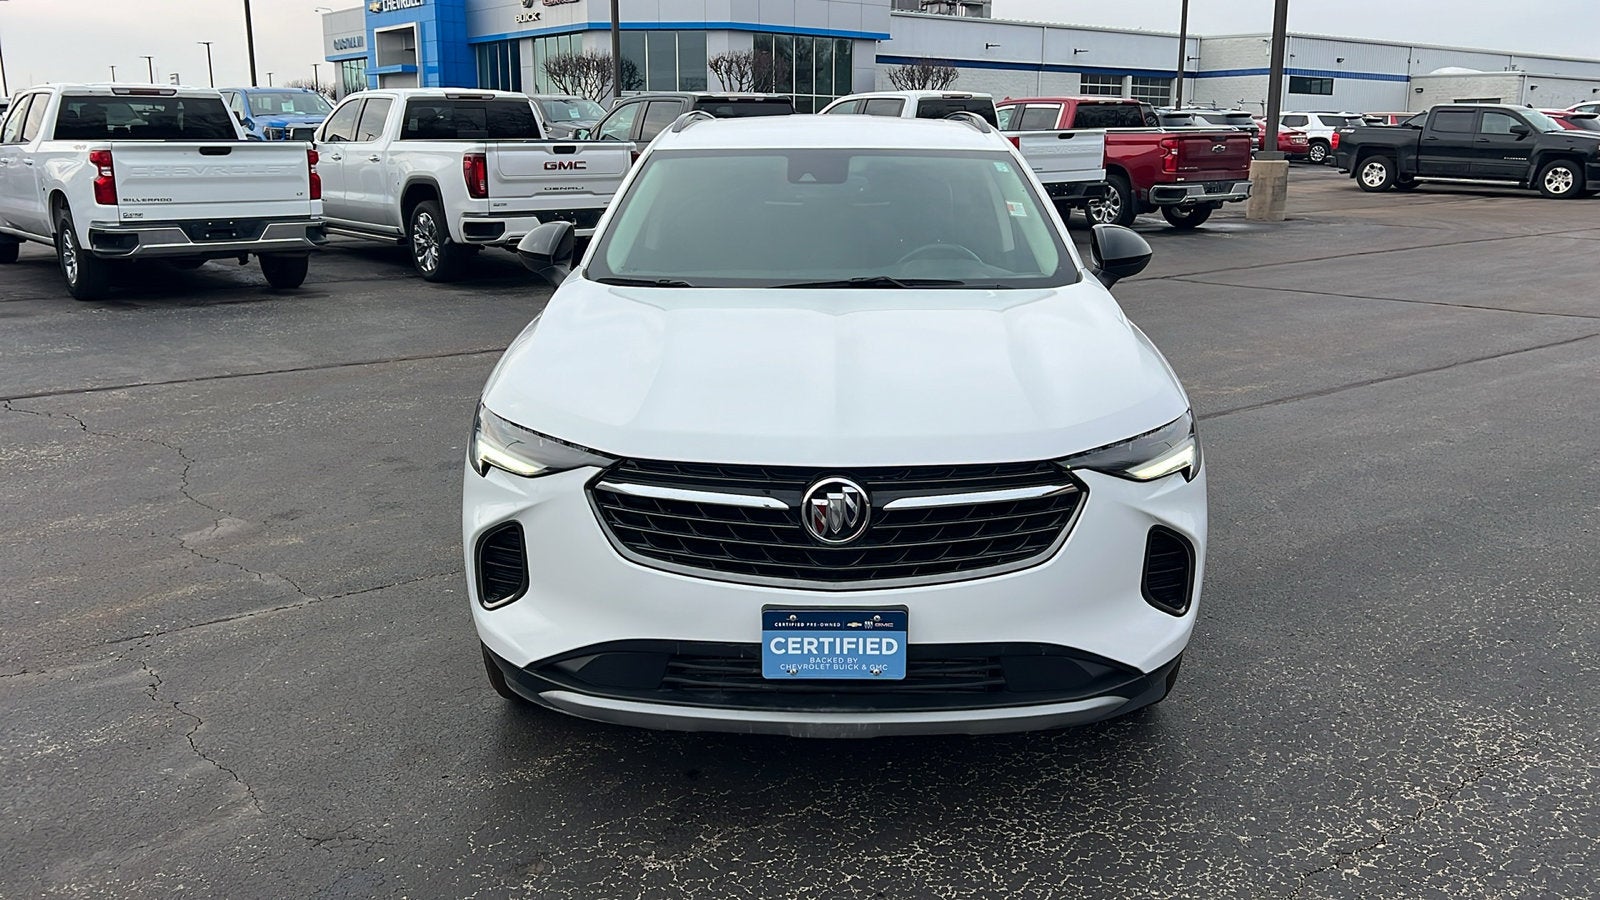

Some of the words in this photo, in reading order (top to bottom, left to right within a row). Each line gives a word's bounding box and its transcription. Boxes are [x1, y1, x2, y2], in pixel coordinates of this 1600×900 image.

[515, 12, 541, 23] BUICK
[129, 164, 298, 178] CHEVROLET
[543, 161, 587, 170] GMC
[769, 637, 899, 655] CERTIFIED
[780, 663, 831, 671] CHEVROLET
[833, 663, 859, 671] BUICK
[869, 663, 889, 671] GMC
